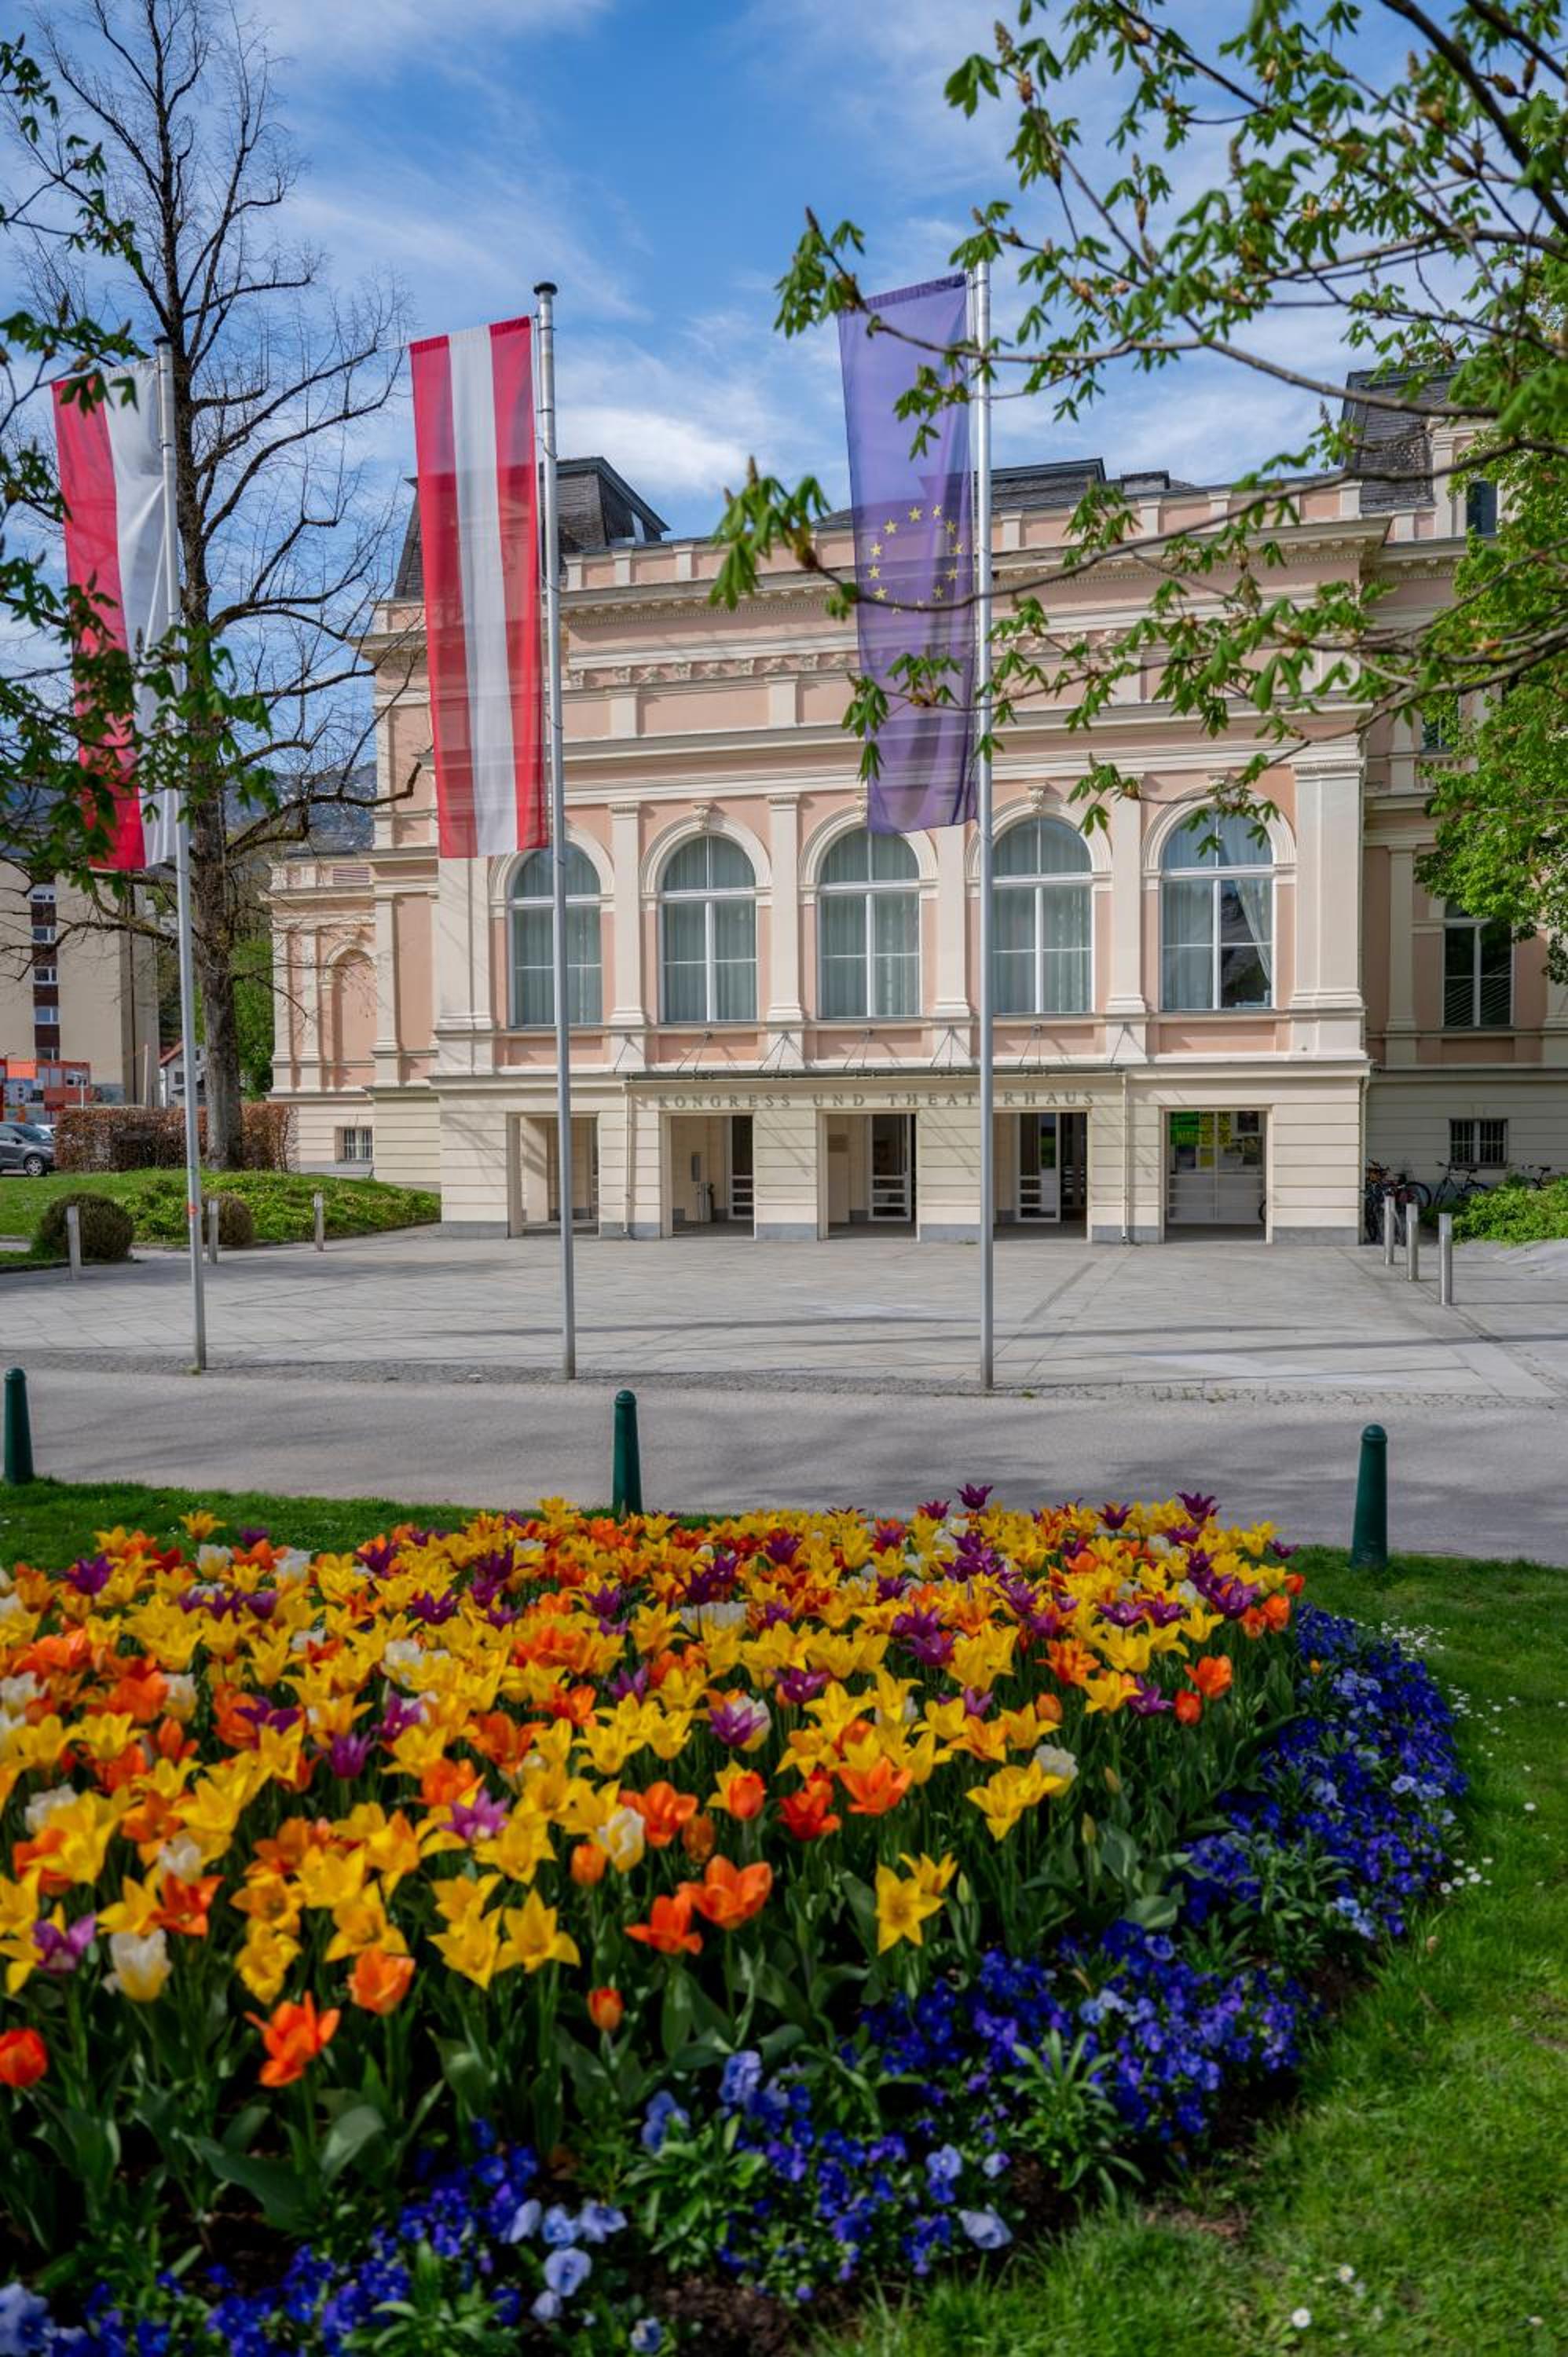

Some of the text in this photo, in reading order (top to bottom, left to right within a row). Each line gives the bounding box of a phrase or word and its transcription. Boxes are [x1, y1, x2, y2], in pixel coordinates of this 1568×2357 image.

[658, 1091, 1094, 1109] KONGRESS UND THEATRHAUS
